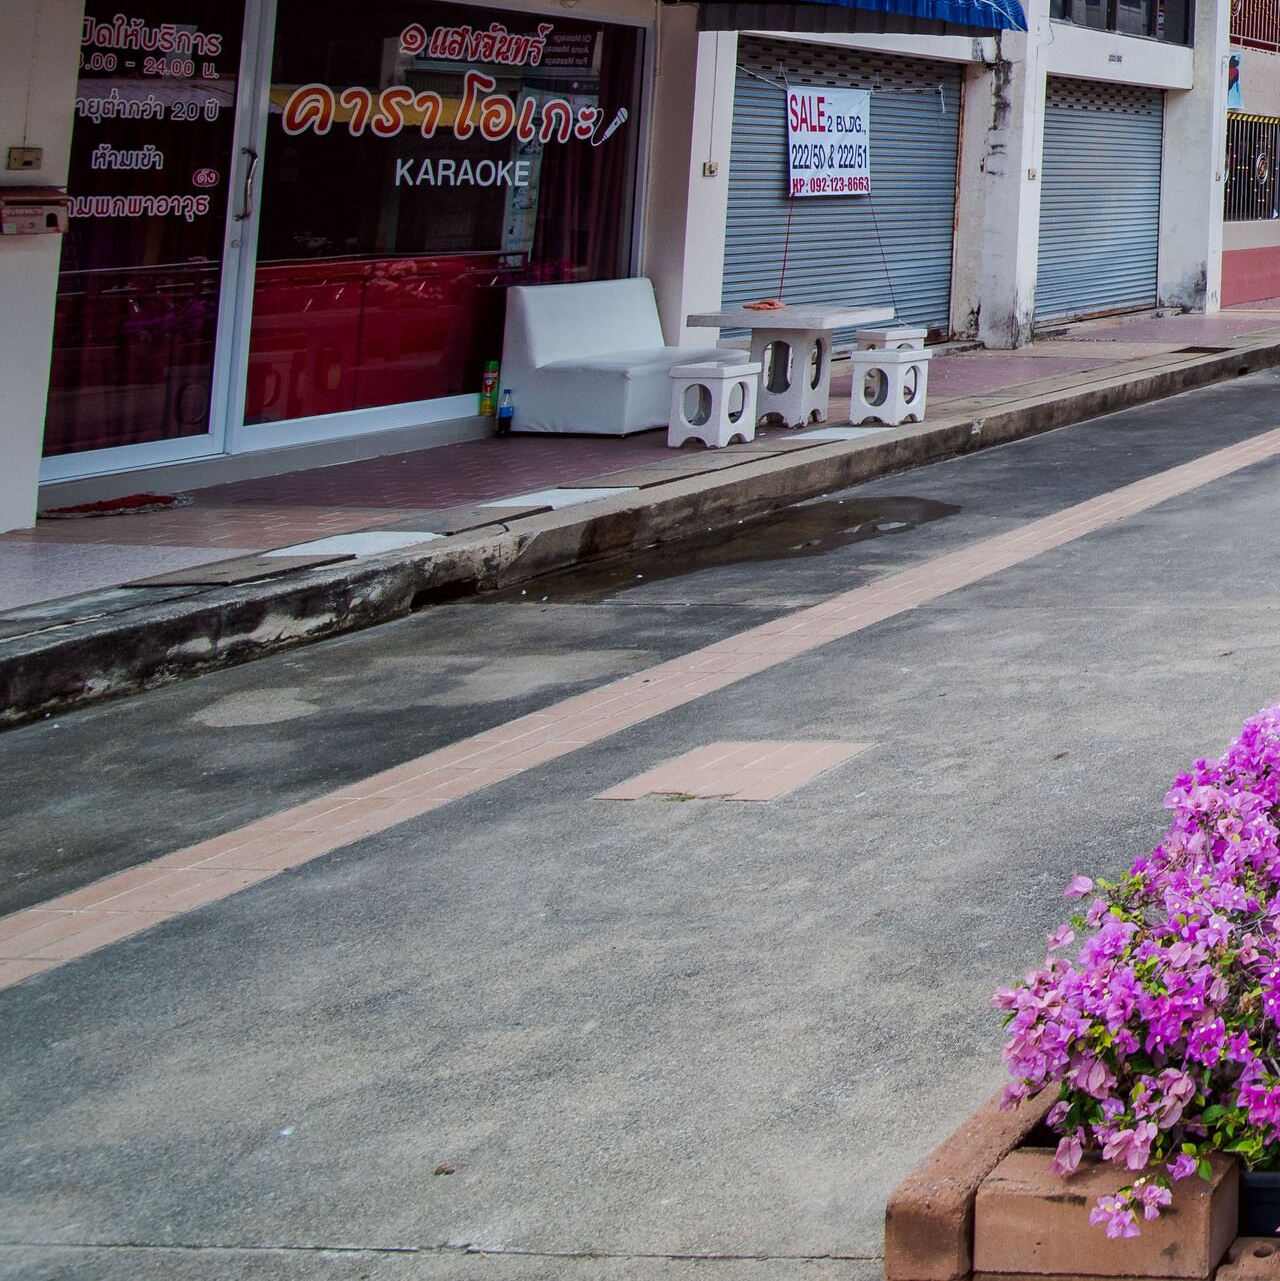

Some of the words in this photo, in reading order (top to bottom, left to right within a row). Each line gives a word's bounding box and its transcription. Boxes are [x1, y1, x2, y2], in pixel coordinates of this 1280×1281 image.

[80, 14, 223, 57] ปิดให้บริการ
[144, 57, 195, 77] 24.00
[75, 88, 165, 124] ายุต่ำกว่า
[171, 101, 200, 121] 20
[204, 99, 219, 122] ปี
[789, 93, 827, 133] SALE
[827, 115, 833, 133] 2
[91, 144, 165, 170] ห้ามเข้า
[791, 143, 826, 170] 222/50
[827, 143, 835, 170] &
[838, 143, 868, 170] 222/51
[395, 158, 531, 187] KARAOKE
[810, 176, 870, 193] 092-123-8663
[67, 195, 210, 223] ามพกพาอาวุธ
